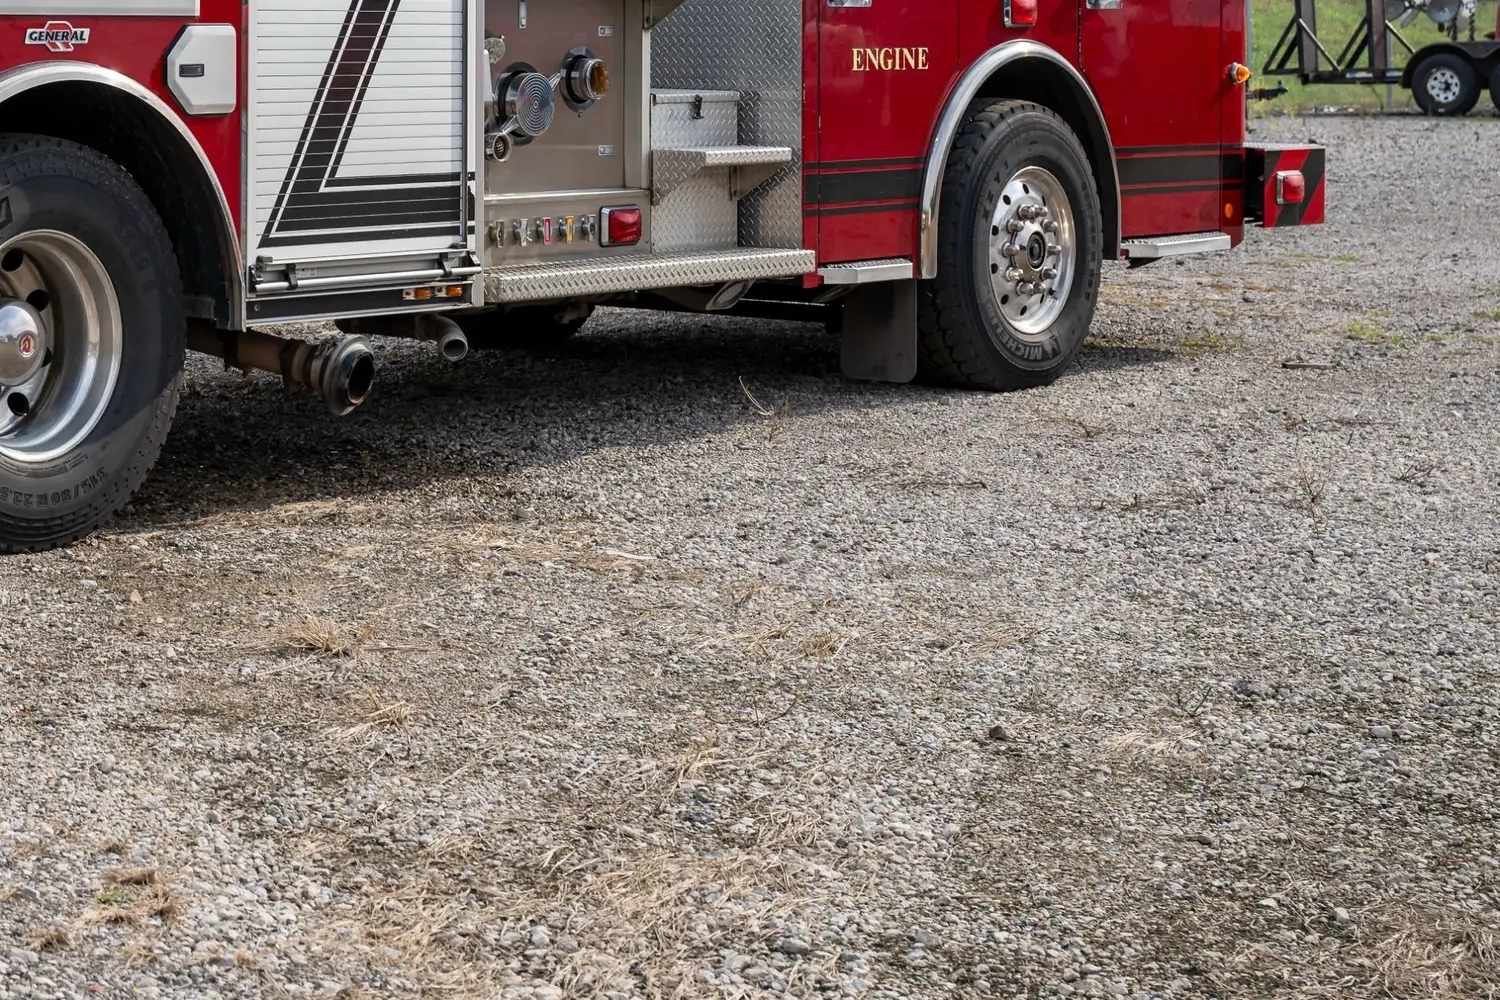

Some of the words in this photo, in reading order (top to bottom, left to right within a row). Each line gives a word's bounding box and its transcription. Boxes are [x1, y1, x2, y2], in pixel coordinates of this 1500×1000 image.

[28, 30, 87, 42] GENERAL
[851, 47, 930, 71] ENGINE
[984, 301, 1043, 360] MICHELIN
